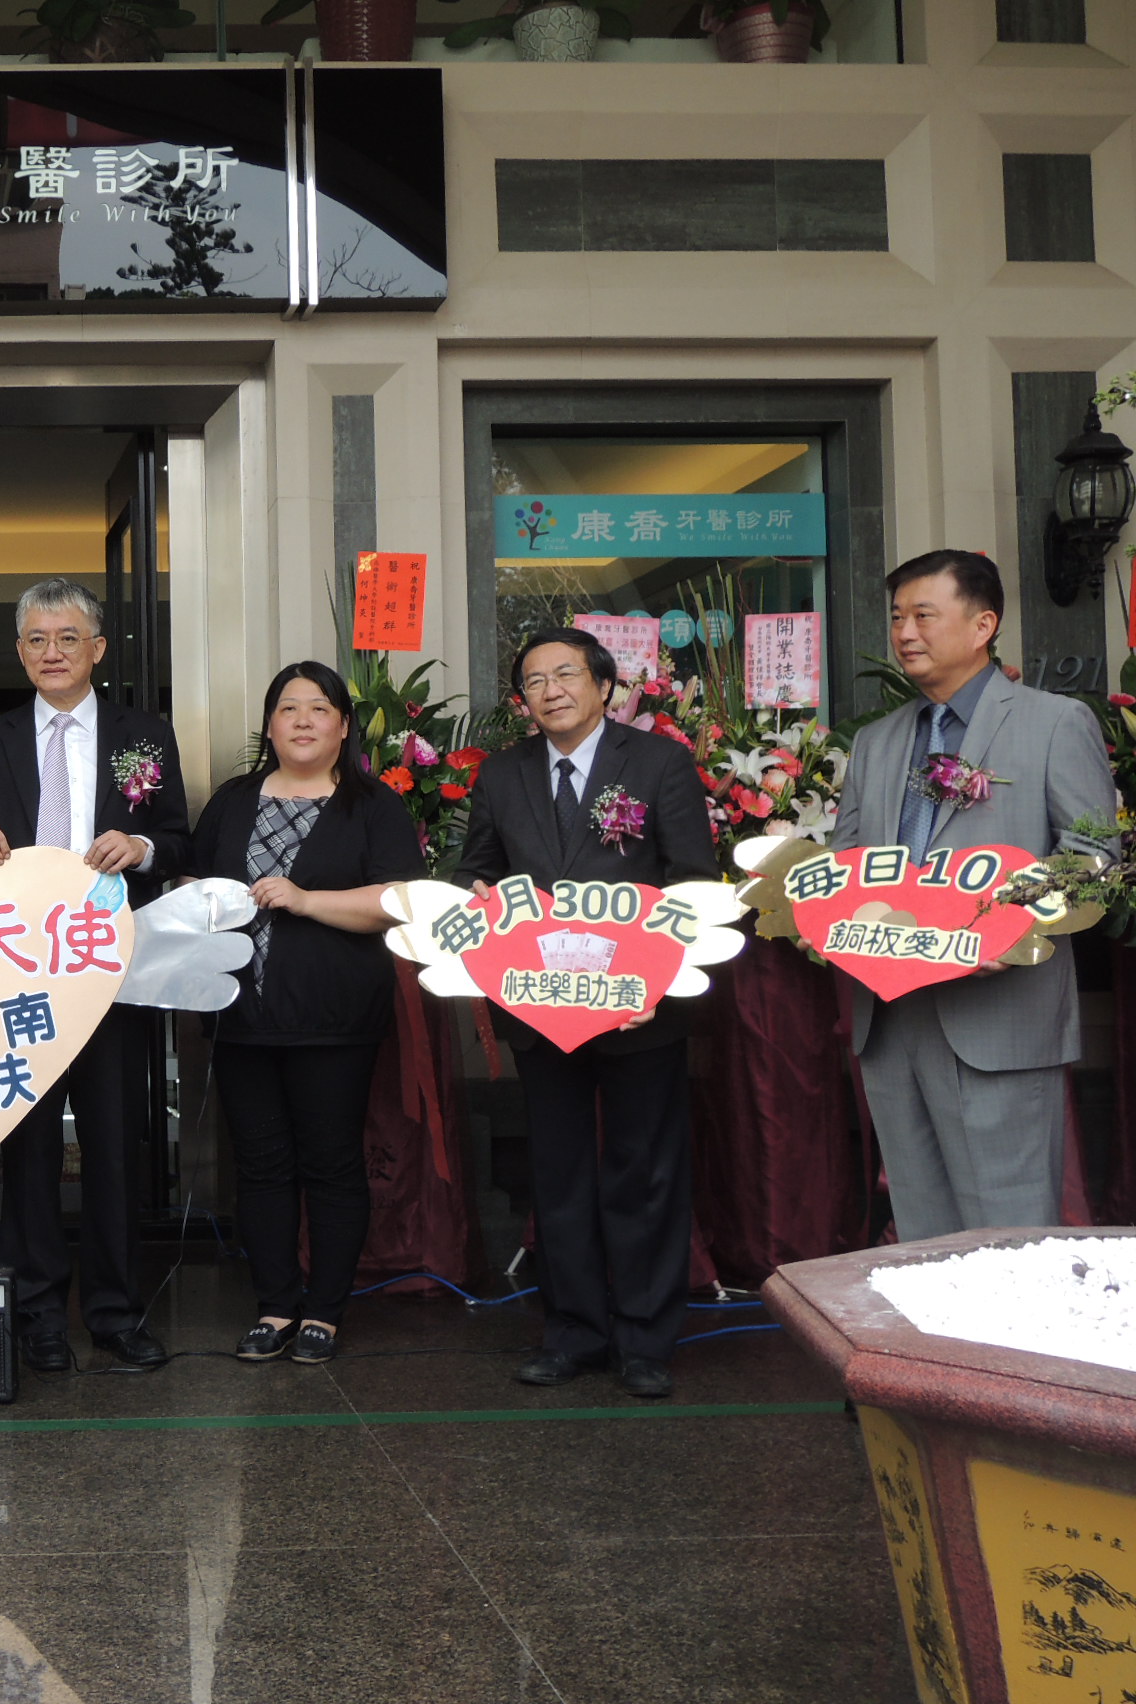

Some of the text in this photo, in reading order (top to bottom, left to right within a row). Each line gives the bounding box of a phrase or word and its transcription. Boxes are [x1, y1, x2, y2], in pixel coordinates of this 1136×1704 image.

[0, 203, 81, 225] Smile
[101, 203, 172, 224] With
[185, 203, 238, 225] You
[571, 508, 794, 542] 康喬牙醫診所
[775, 617, 796, 704] 開業誌慶
[1033, 654, 1104, 692] 121
[431, 876, 699, 954] 每月300元
[825, 921, 979, 964] 銅板愛心
[503, 970, 644, 1010] 快樂助養
